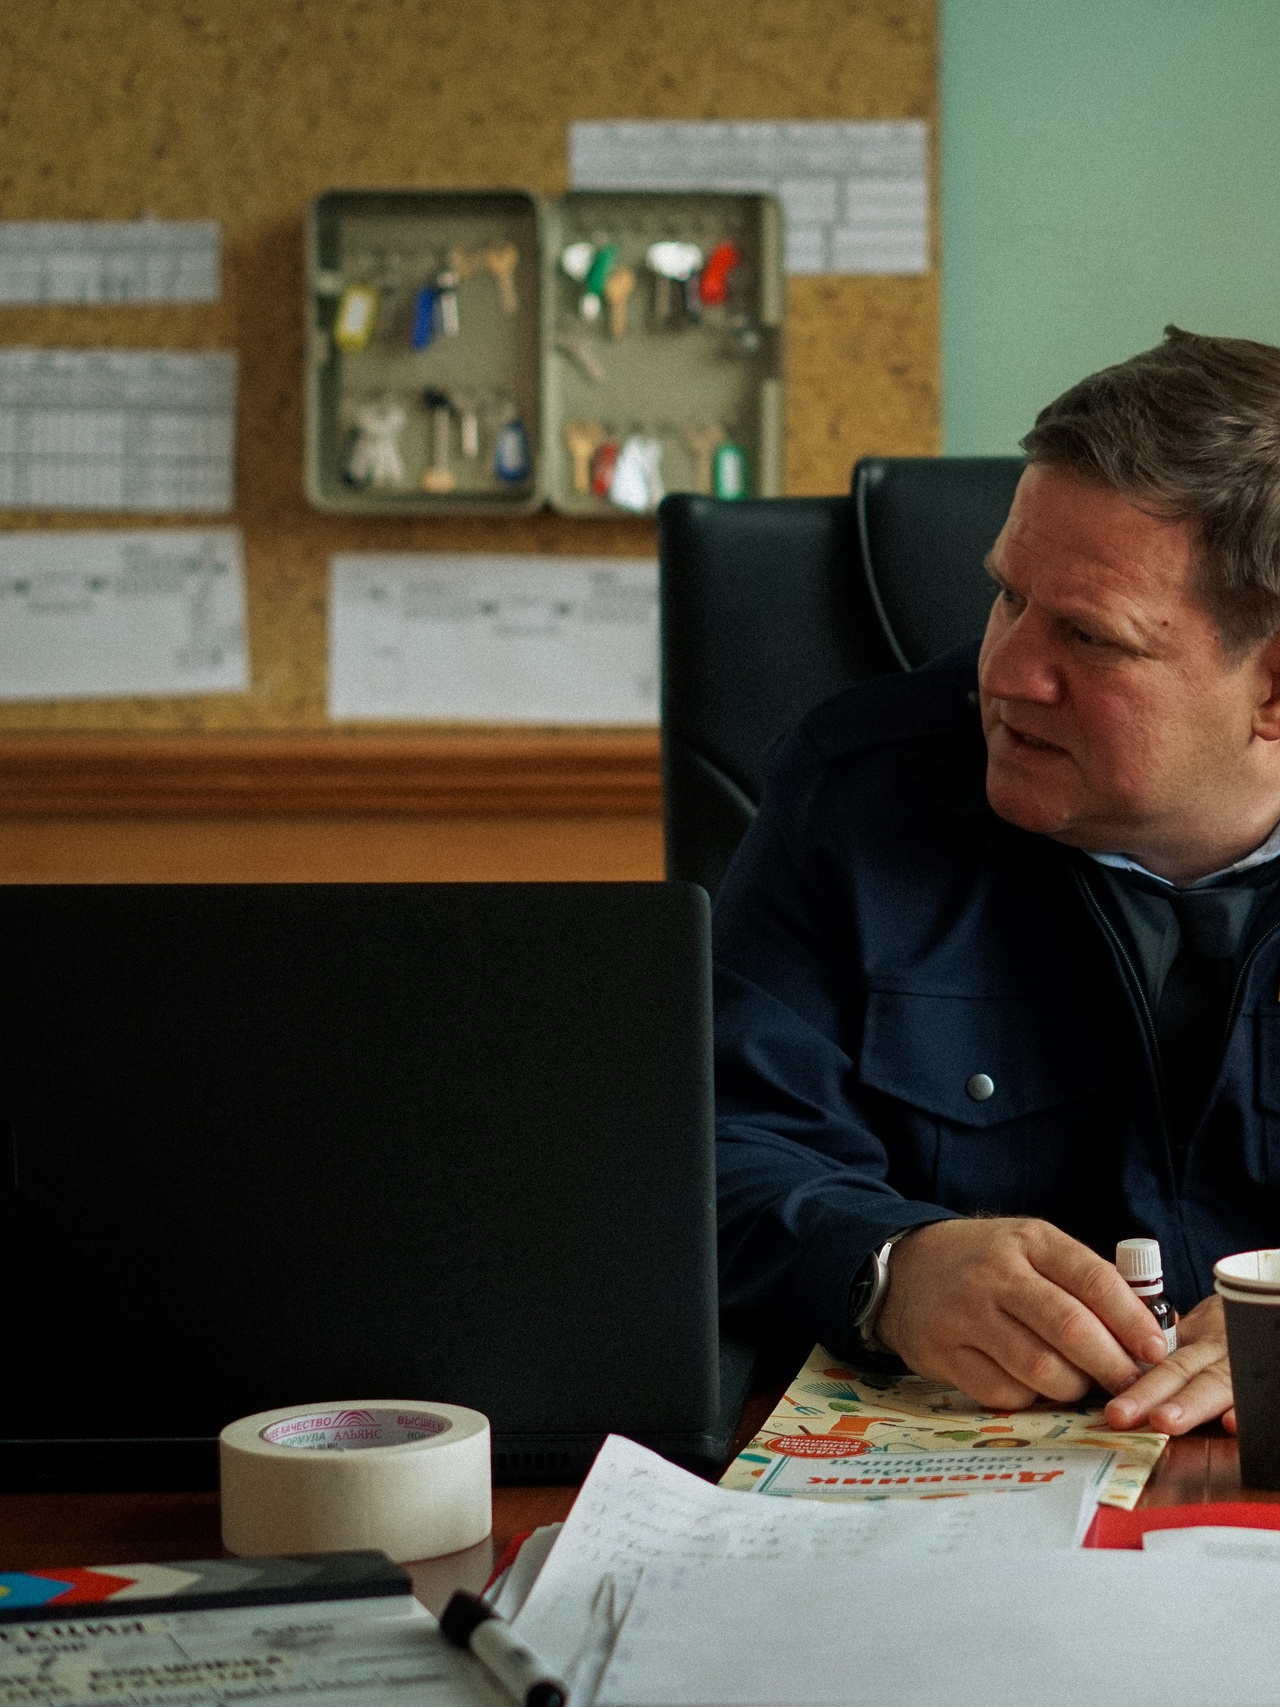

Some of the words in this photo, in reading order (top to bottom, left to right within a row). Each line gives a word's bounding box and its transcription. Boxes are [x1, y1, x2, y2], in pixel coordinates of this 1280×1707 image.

[281, 1416, 332, 1434] КАЧЕСТВО
[334, 1428, 383, 1441] АЛЬЯНС
[829, 1455, 1040, 1467] огородника
[862, 1463, 1022, 1476] садовода
[806, 1470, 1065, 1485] Дневник
